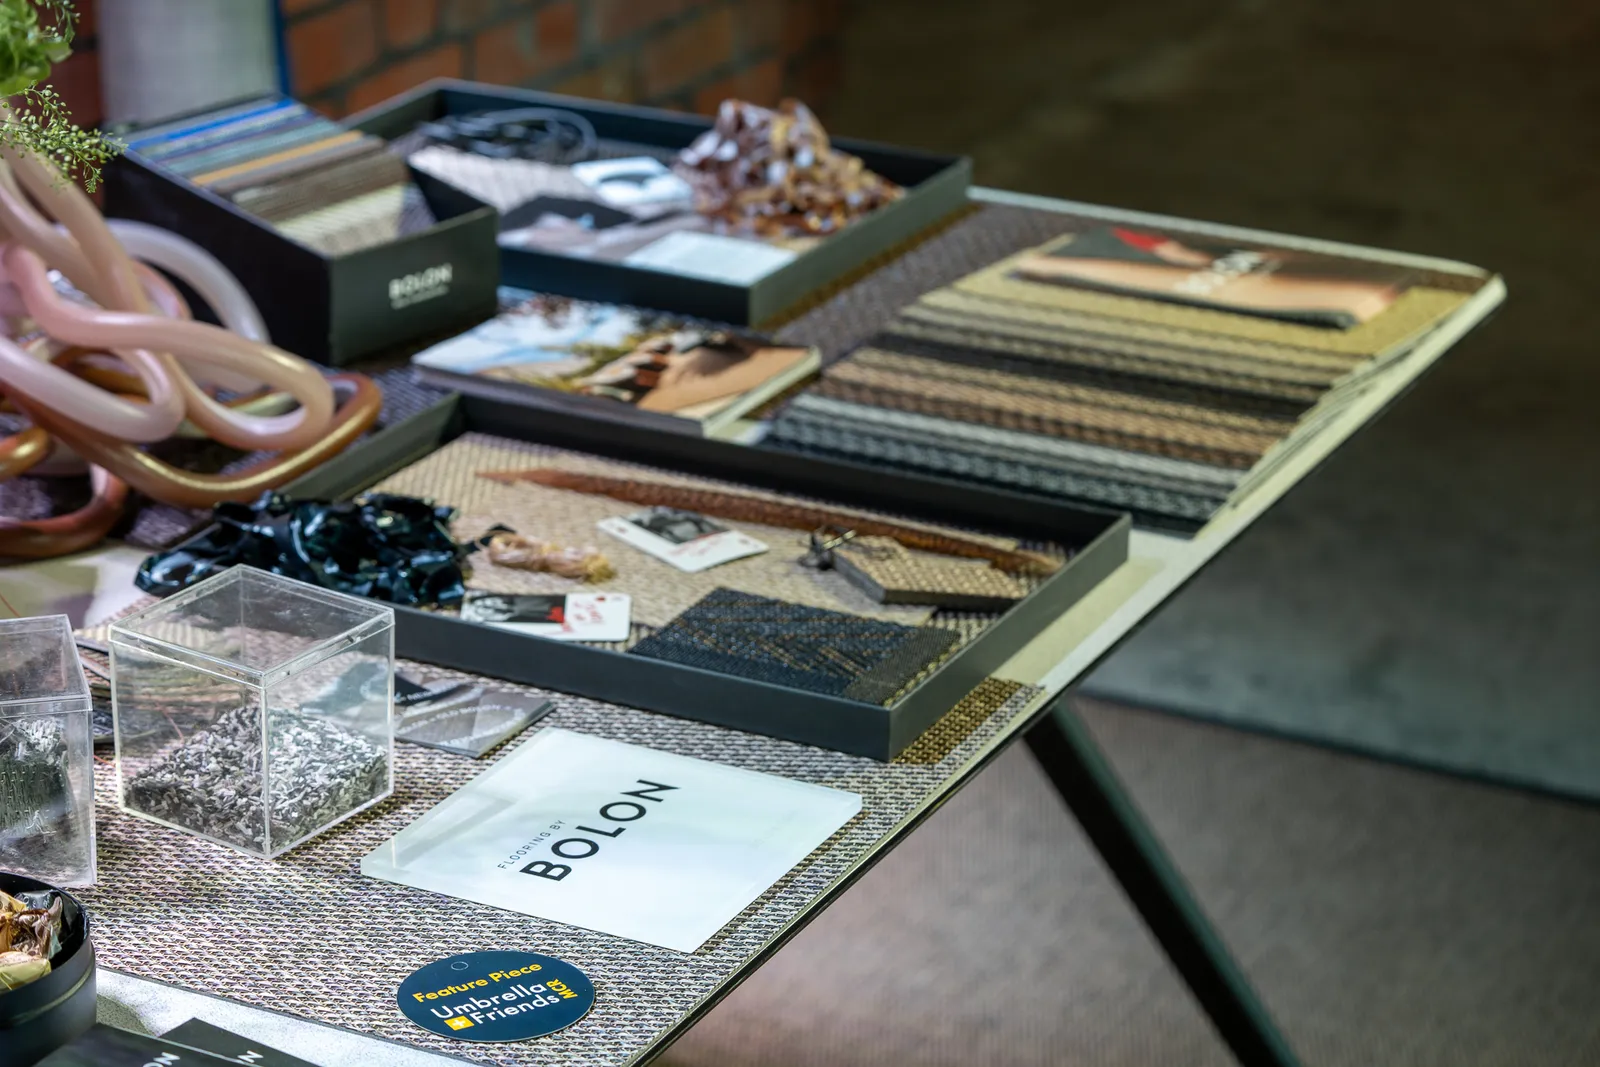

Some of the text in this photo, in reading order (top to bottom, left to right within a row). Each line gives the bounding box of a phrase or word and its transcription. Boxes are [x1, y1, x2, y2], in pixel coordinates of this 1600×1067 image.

[388, 262, 453, 300] BOLON
[497, 819, 566, 870] FLOORING BY
[519, 779, 681, 882] BOLON
[412, 963, 542, 1003] Feature Piece
[430, 983, 547, 1019] Umbrella
[546, 978, 578, 1000] MCR
[469, 994, 560, 1024] Friends
